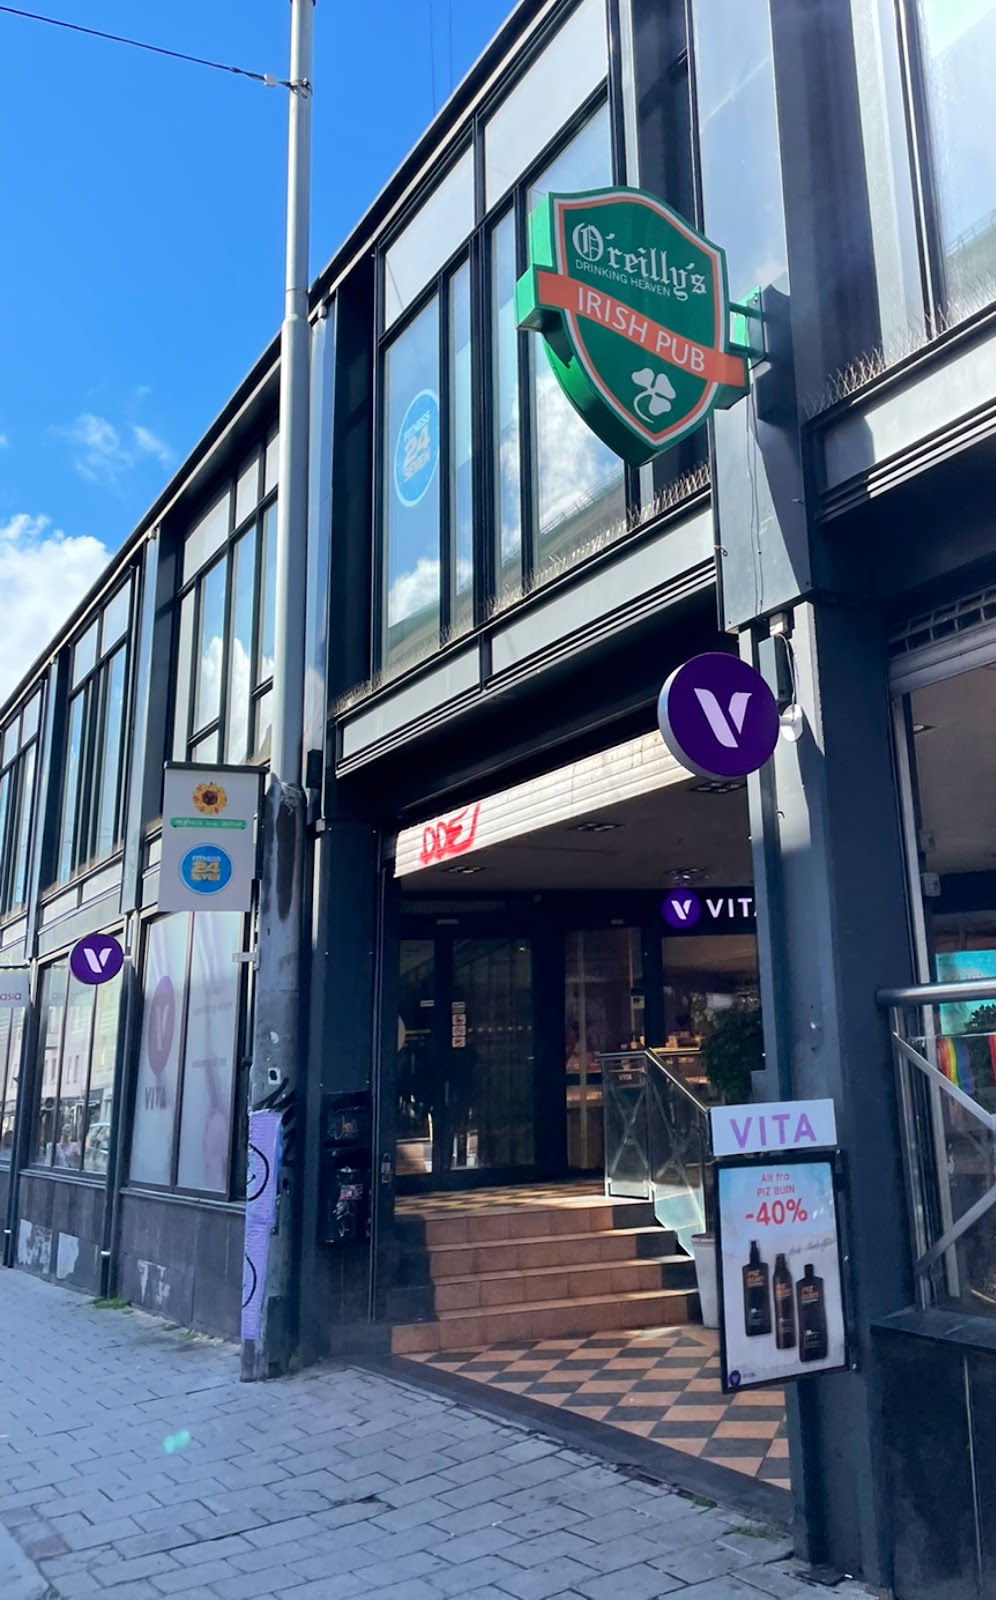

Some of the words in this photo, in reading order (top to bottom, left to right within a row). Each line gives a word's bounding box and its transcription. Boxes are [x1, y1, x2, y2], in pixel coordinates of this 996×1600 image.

[575, 259, 628, 284] DRINKING
[630, 276, 671, 297] HEAVEN
[578, 287, 648, 343] IRISH
[655, 330, 705, 372] PUB
[191, 862, 219, 873] 24
[706, 898, 758, 918] VIT
[729, 1112, 817, 1149] VITA
[761, 1174, 773, 1183] Alt
[776, 1173, 790, 1181] fra
[774, 1185, 796, 1195] BUIN
[745, 1198, 808, 1226] -40%
